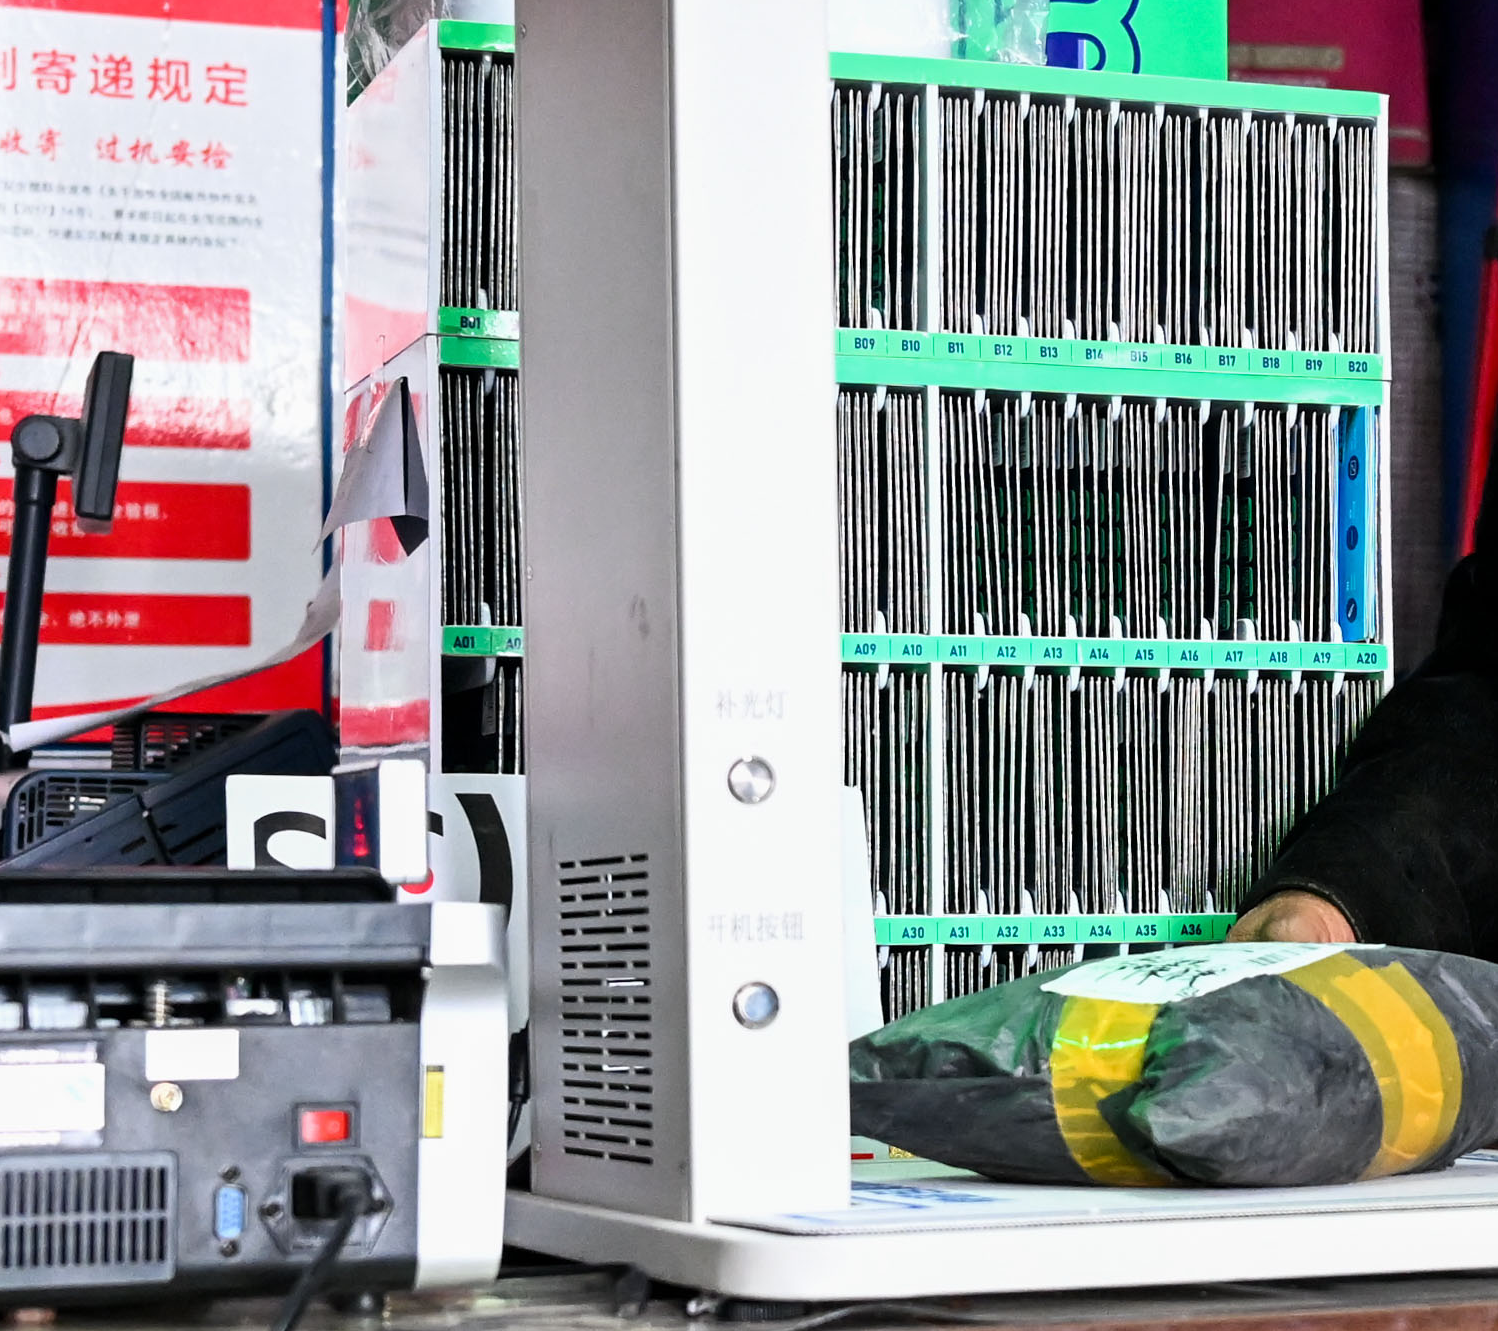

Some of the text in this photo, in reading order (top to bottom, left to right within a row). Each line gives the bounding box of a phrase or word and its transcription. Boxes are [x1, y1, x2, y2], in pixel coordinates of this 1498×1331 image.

[93, 132, 234, 171] 过机安检
[459, 315, 481, 330] B01
[854, 336, 1369, 374] B09 B10 B11 B12 B13 B14 B15 B16 B17 B18 B19 B20
[453, 635, 521, 650] A01 A0
[854, 641, 1378, 666] A09 A10 A11 A12 A13 A14 A15 A16 A17 A18 A19 A20
[715, 688, 789, 720] 补光灯
[707, 911, 806, 943] 开机按钮
[901, 922, 1203, 940] A30 A31 A32 A33 A34 A35 A36
